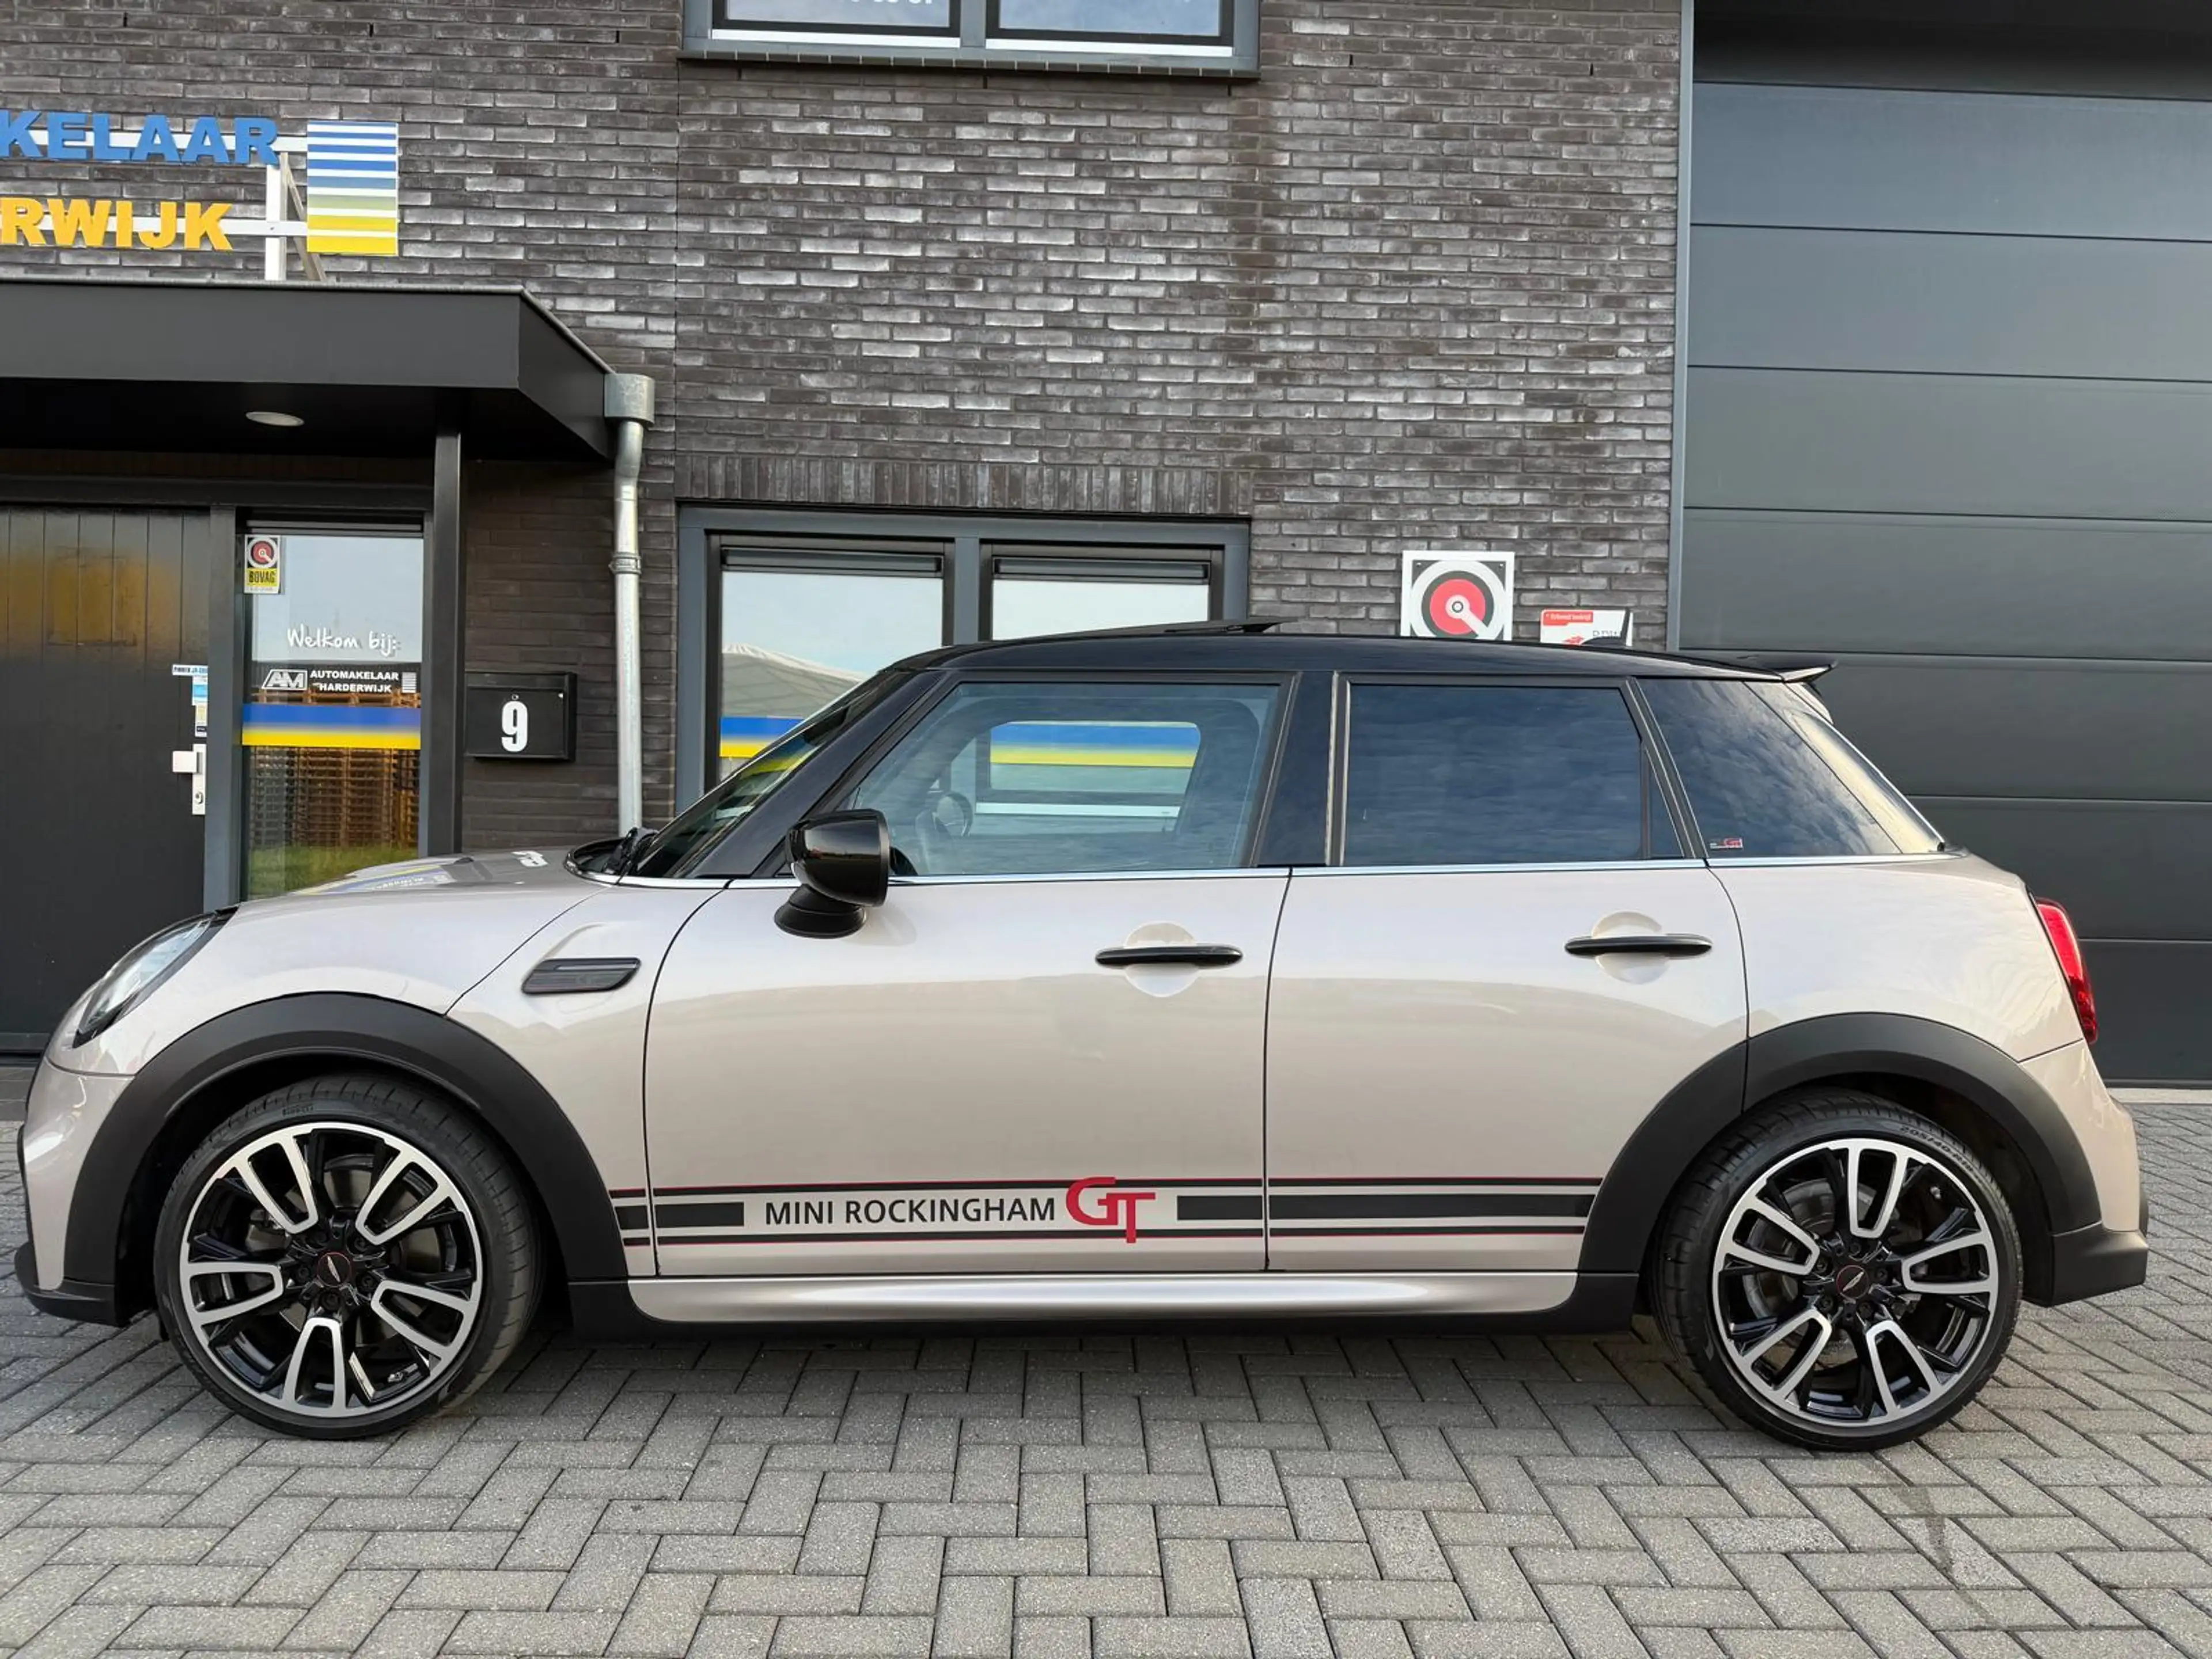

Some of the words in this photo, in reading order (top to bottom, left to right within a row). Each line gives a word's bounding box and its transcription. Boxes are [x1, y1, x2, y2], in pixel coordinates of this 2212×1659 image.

[0, 109, 279, 165] KELAAR
[1, 198, 233, 251] RWIJK
[249, 571, 275, 584] BOVAG
[287, 624, 358, 647] Welkom
[310, 670, 400, 680] AUTOMAKELAAR
[319, 683, 392, 692] HARDERWIJK
[501, 700, 528, 752] 9
[766, 1200, 833, 1225] MINI
[845, 1198, 1055, 1224] ROCKINGHAM
[1066, 1176, 1156, 1243] GT
